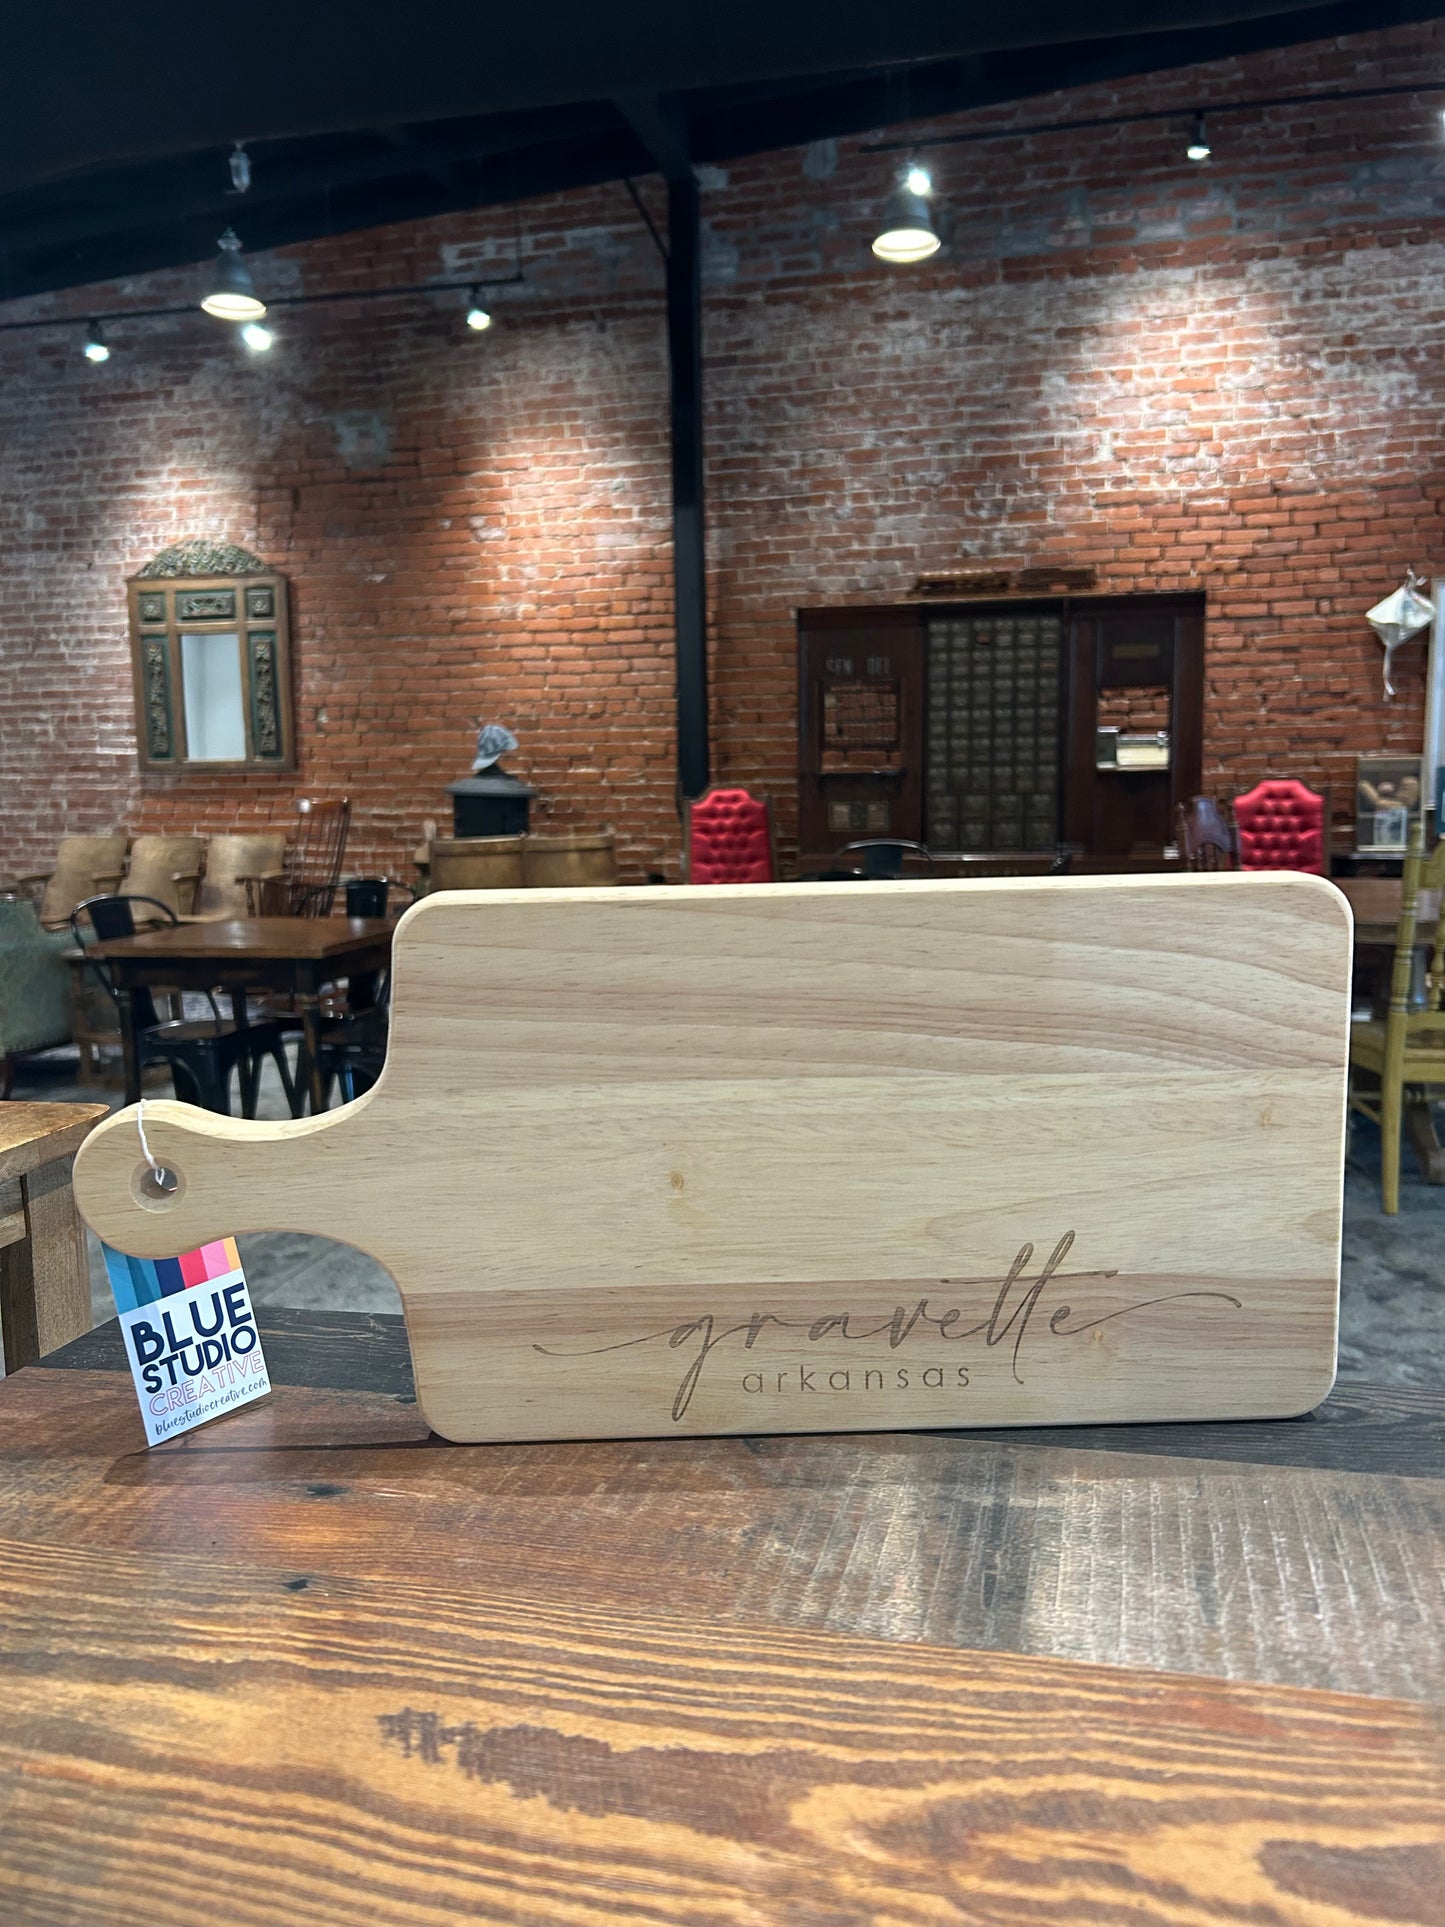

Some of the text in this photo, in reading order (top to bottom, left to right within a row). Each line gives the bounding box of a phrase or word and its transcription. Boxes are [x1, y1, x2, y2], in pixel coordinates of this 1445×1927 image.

[131, 1282, 252, 1366] BLUE
[142, 1325, 257, 1394] STUDIO
[149, 1351, 265, 1416] CREATIVE
[742, 1364, 970, 1394] arkansas
[155, 1377, 267, 1435] bluestudiocreative.com
